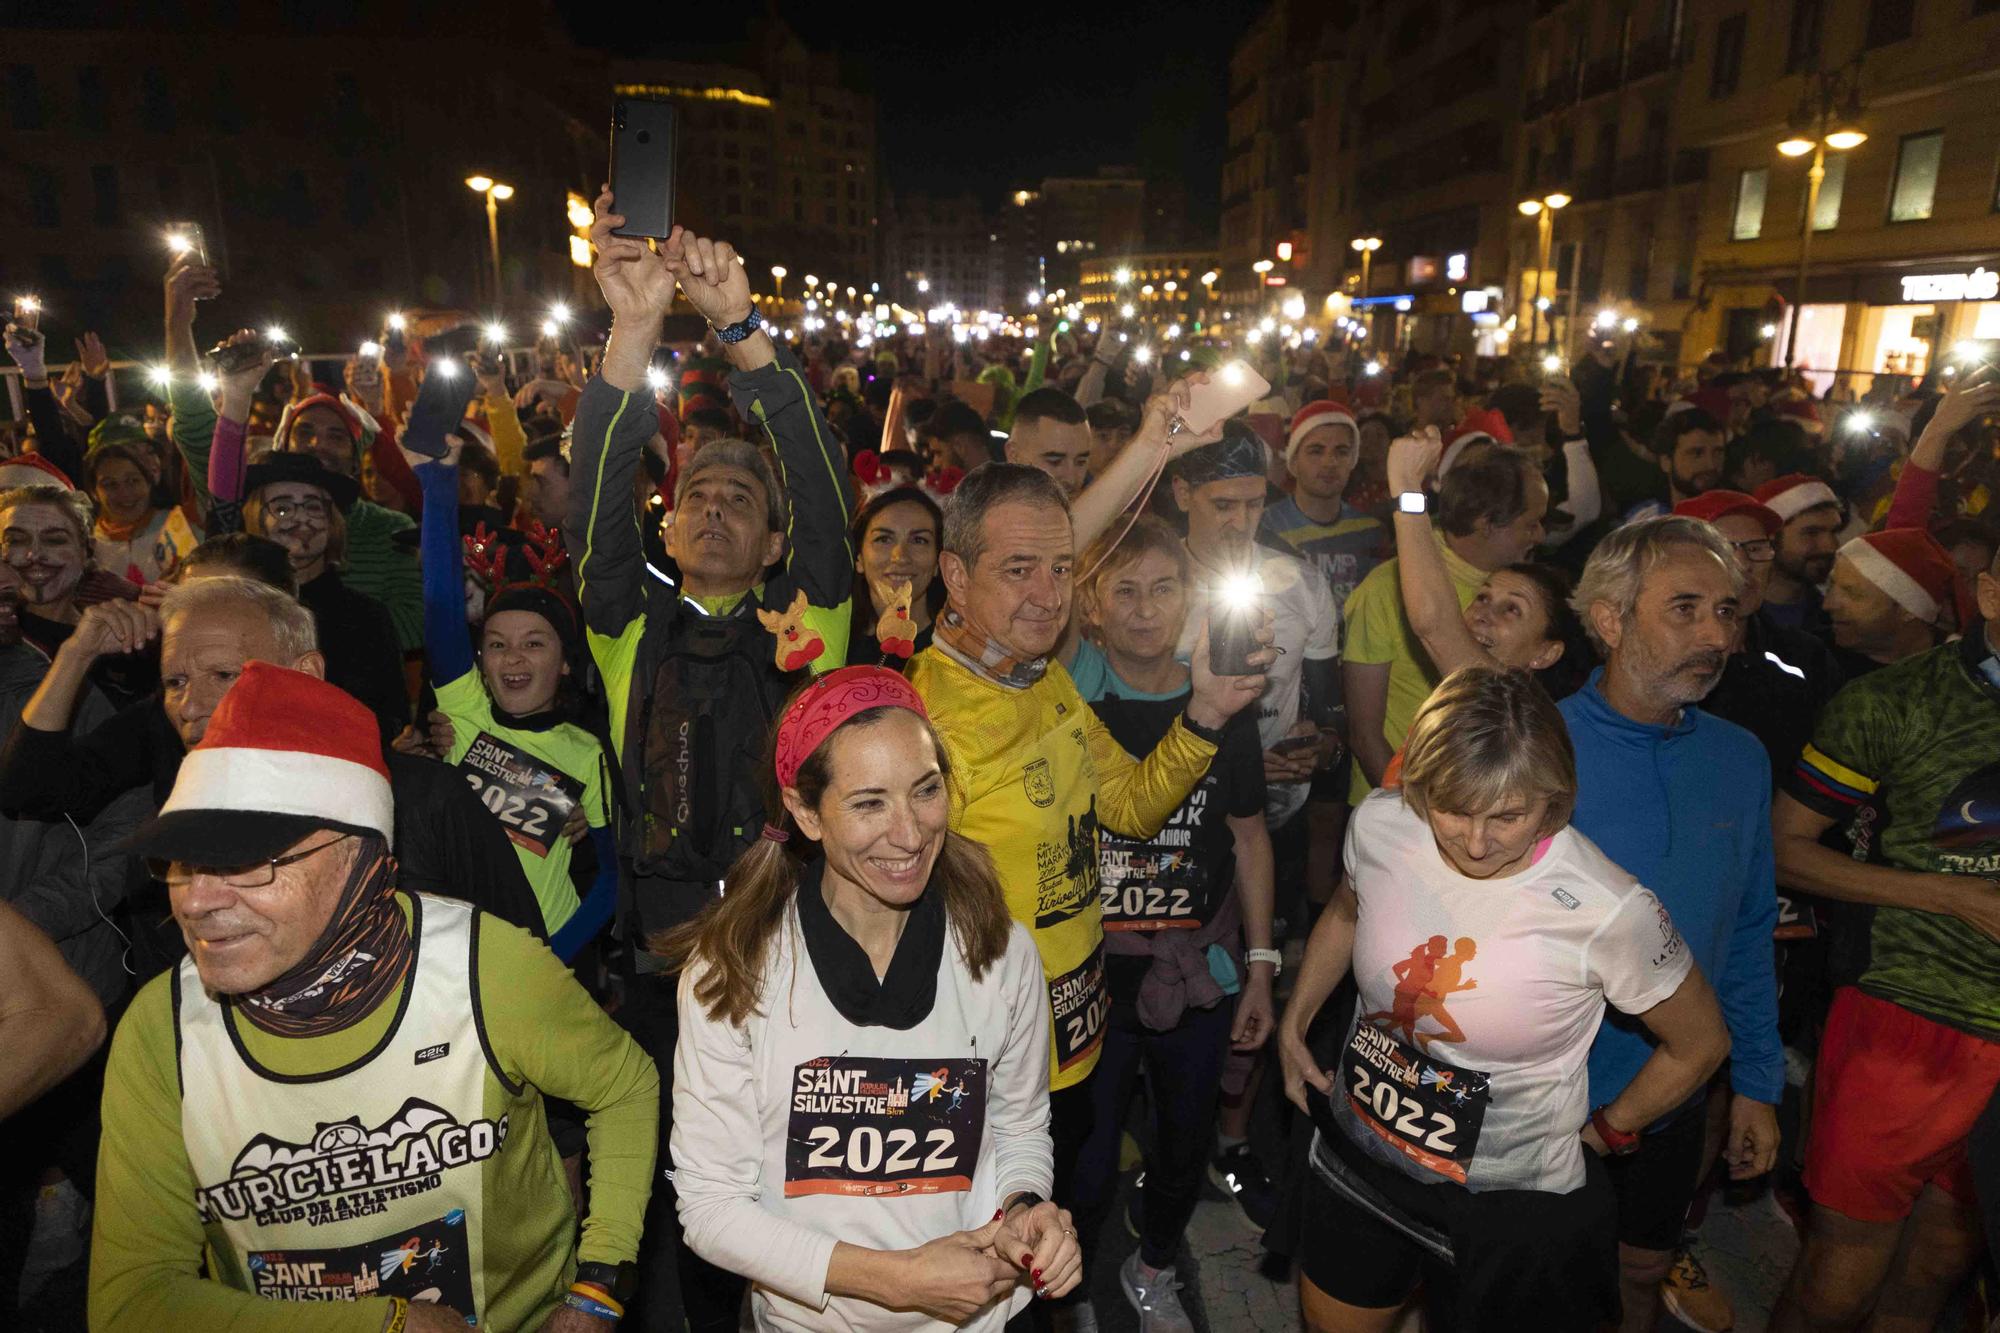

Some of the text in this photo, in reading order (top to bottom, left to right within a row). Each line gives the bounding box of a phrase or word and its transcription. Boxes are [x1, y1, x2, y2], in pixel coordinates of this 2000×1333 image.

[472, 740, 514, 766] SANT
[676, 721, 689, 822] Quechua
[1037, 843, 1061, 860] MITJA
[1101, 851, 1133, 867] ANT
[1100, 886, 1193, 917] 2022
[1052, 970, 1087, 1005] SANT
[1359, 1026, 1399, 1058] SANT
[797, 1068, 867, 1095] SANT
[1354, 1065, 1457, 1153] 2022
[808, 1126, 959, 1174] 2022
[256, 1174, 442, 1226] CLUB DE ATLETISMO
[308, 1202, 387, 1227] VALENCIA
[259, 1263, 326, 1285] SANT
